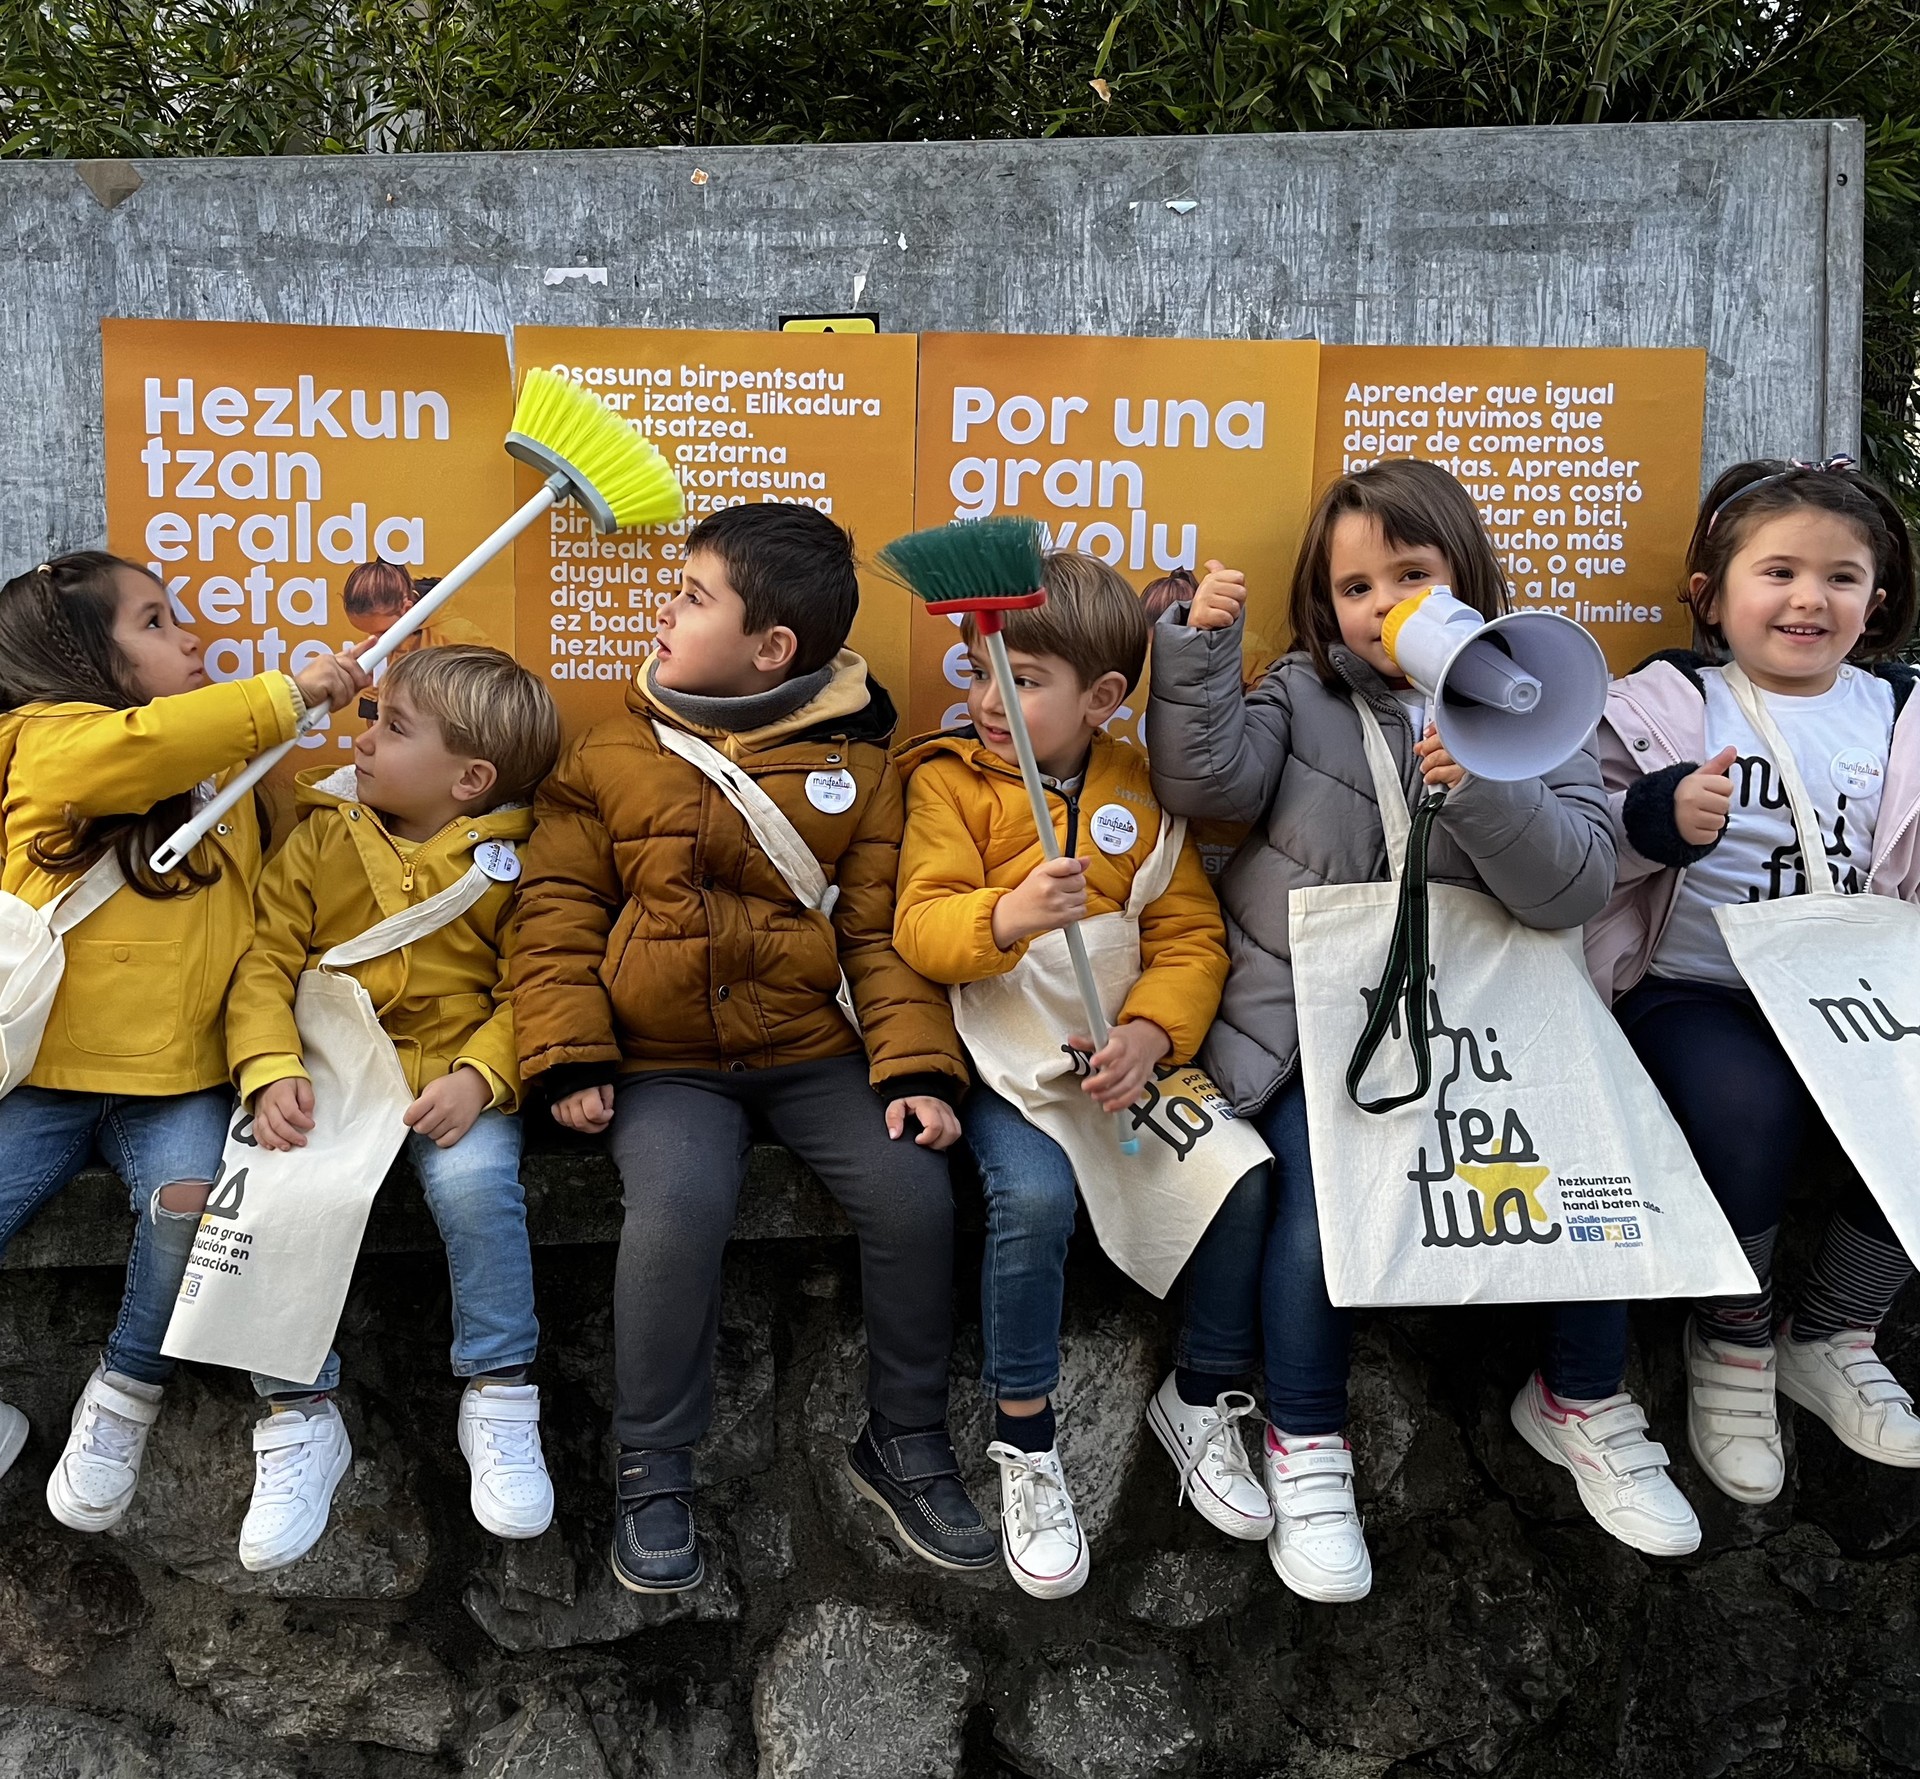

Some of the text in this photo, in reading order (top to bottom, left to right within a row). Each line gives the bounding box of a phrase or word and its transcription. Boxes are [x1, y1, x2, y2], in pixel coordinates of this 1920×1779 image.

[550, 364, 844, 392] Osasuna birpentsatu
[144, 375, 450, 440] Hezkun
[644, 387, 737, 414] izatea.
[746, 393, 881, 417] Elikadura
[1344, 381, 1614, 410] Aprender que igual
[627, 415, 754, 439] ntsatzea.
[951, 386, 1265, 449] Por una
[1344, 406, 1602, 434] nunca tuvimos que
[675, 441, 787, 464] aztarna
[1343, 430, 1604, 456] dejar de comernos
[141, 436, 321, 500] tzan
[674, 464, 826, 490] ikortasuna
[1507, 457, 1640, 481] Aprender
[949, 457, 1143, 518] gran
[1514, 485, 1561, 502] nos
[1569, 480, 1643, 503] costó
[1532, 508, 1566, 526] en
[1574, 504, 1628, 529] bici,
[145, 501, 424, 565] eralda
[1566, 528, 1623, 551] más
[550, 535, 653, 560] izateak
[550, 561, 648, 588] dugula
[1547, 554, 1568, 575] O
[1574, 557, 1627, 579] que
[550, 584, 672, 612] digu. Eta
[1525, 580, 1542, 598] a
[1550, 576, 1576, 599] la
[550, 613, 582, 632] ez
[1574, 599, 1663, 623] límites
[1182, 1074, 1201, 1086] por
[1201, 1094, 1216, 1103] la
[1558, 1176, 1631, 1187] hezkuntzan
[1561, 1187, 1632, 1198] eraldaketa
[1563, 1200, 1599, 1211] handi
[1602, 1200, 1640, 1209] baten
[220, 1229, 253, 1245] gran
[231, 1248, 249, 1260] en
